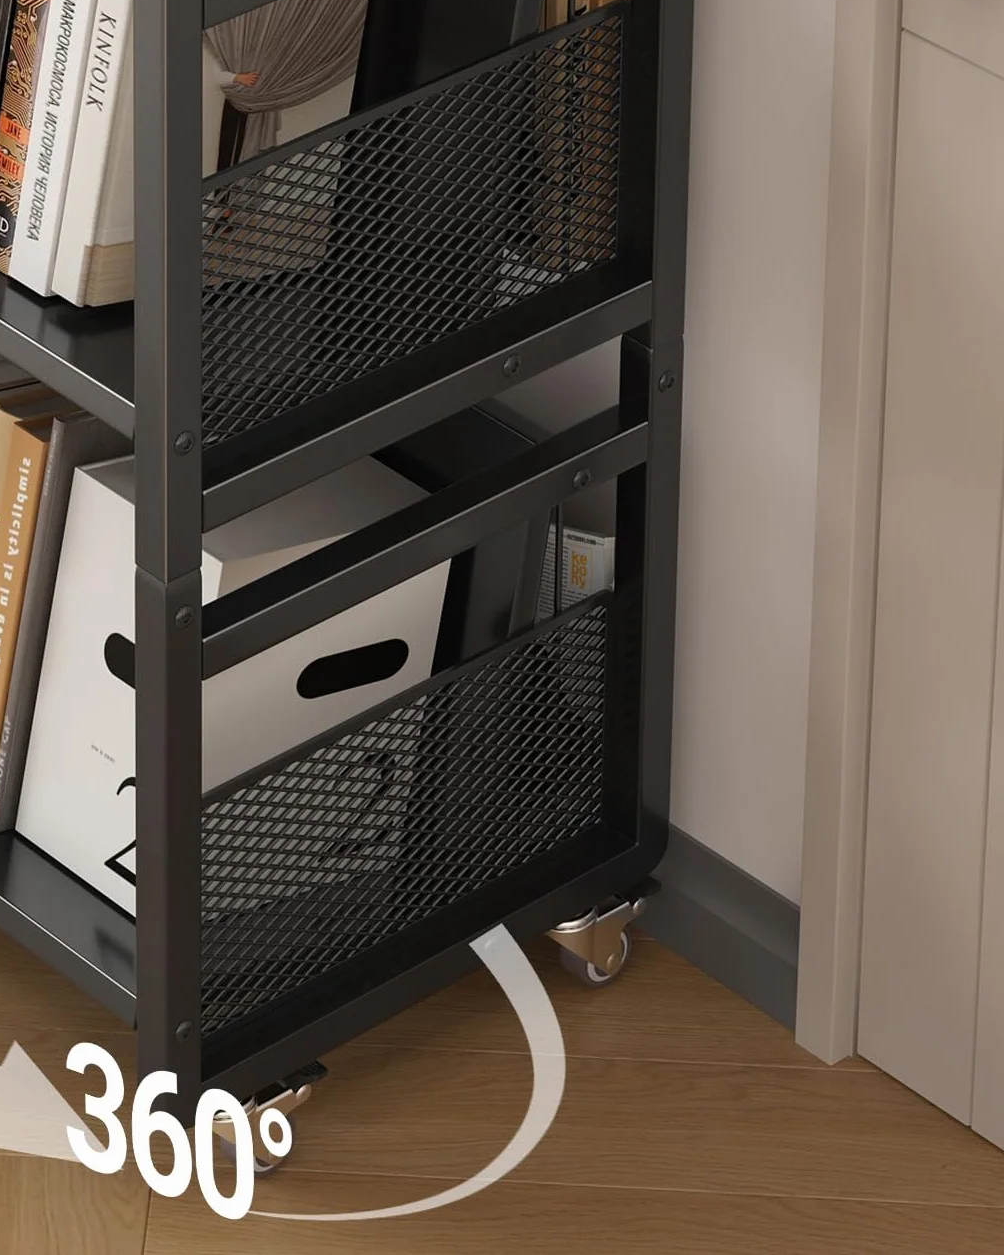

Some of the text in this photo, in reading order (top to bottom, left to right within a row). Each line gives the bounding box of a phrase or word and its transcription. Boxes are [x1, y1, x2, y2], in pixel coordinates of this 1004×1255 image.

[85, 11, 117, 113] KINFOLK
[6, 123, 21, 139] JANE
[37, 109, 59, 173] ИСТОРИЯ
[26, 174, 48, 242] ЧЕЛОВЕКА
